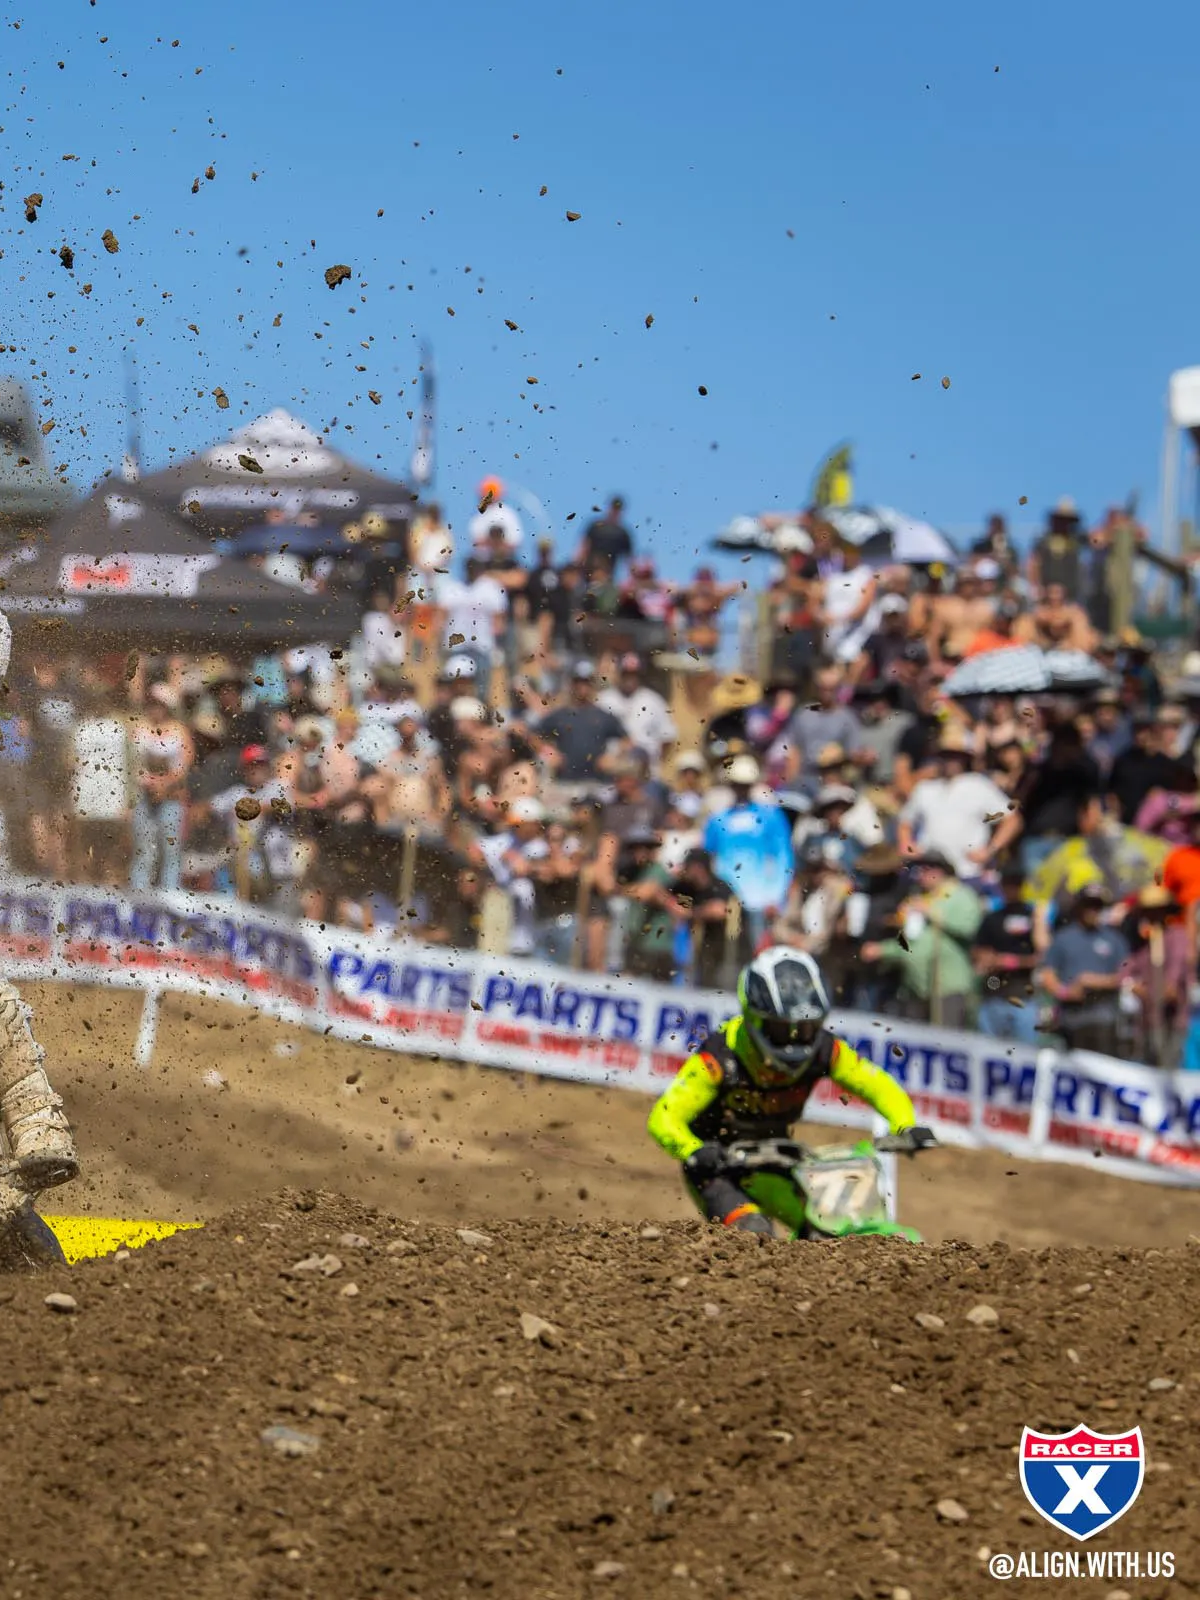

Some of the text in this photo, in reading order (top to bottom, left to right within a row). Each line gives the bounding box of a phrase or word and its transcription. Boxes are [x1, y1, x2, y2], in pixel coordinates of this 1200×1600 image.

[329, 951, 473, 1010] PARTS
[484, 976, 641, 1042] PARTS
[809, 1167, 877, 1220] 77
